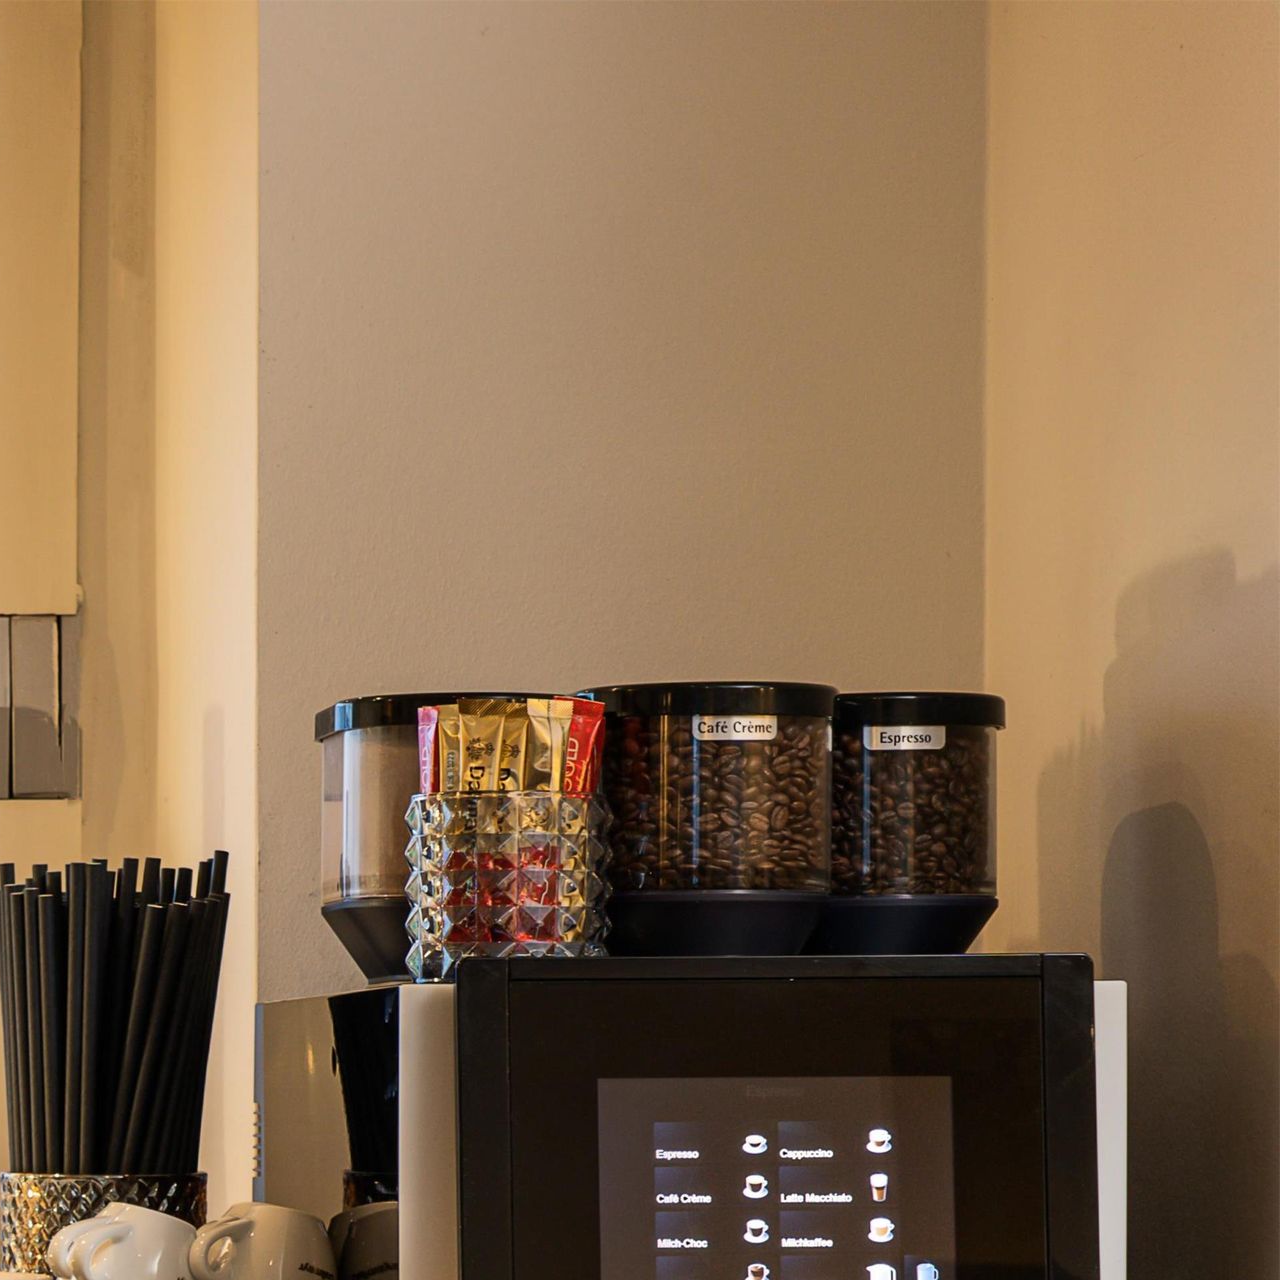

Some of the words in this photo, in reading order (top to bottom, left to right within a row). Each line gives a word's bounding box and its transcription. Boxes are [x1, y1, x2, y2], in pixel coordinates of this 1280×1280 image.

[697, 720, 728, 734] Café
[733, 720, 772, 734] Crème
[880, 731, 932, 745] Espresso
[656, 1149, 699, 1161] Espresso
[779, 1148, 833, 1161] Cappuccino
[656, 1192, 679, 1205] Café
[681, 1192, 712, 1205] Crème
[780, 1193, 804, 1204] Latte
[805, 1193, 853, 1204] Macchiato
[657, 1238, 708, 1249] Milch-Choc
[781, 1237, 833, 1249] Milchkaffee
